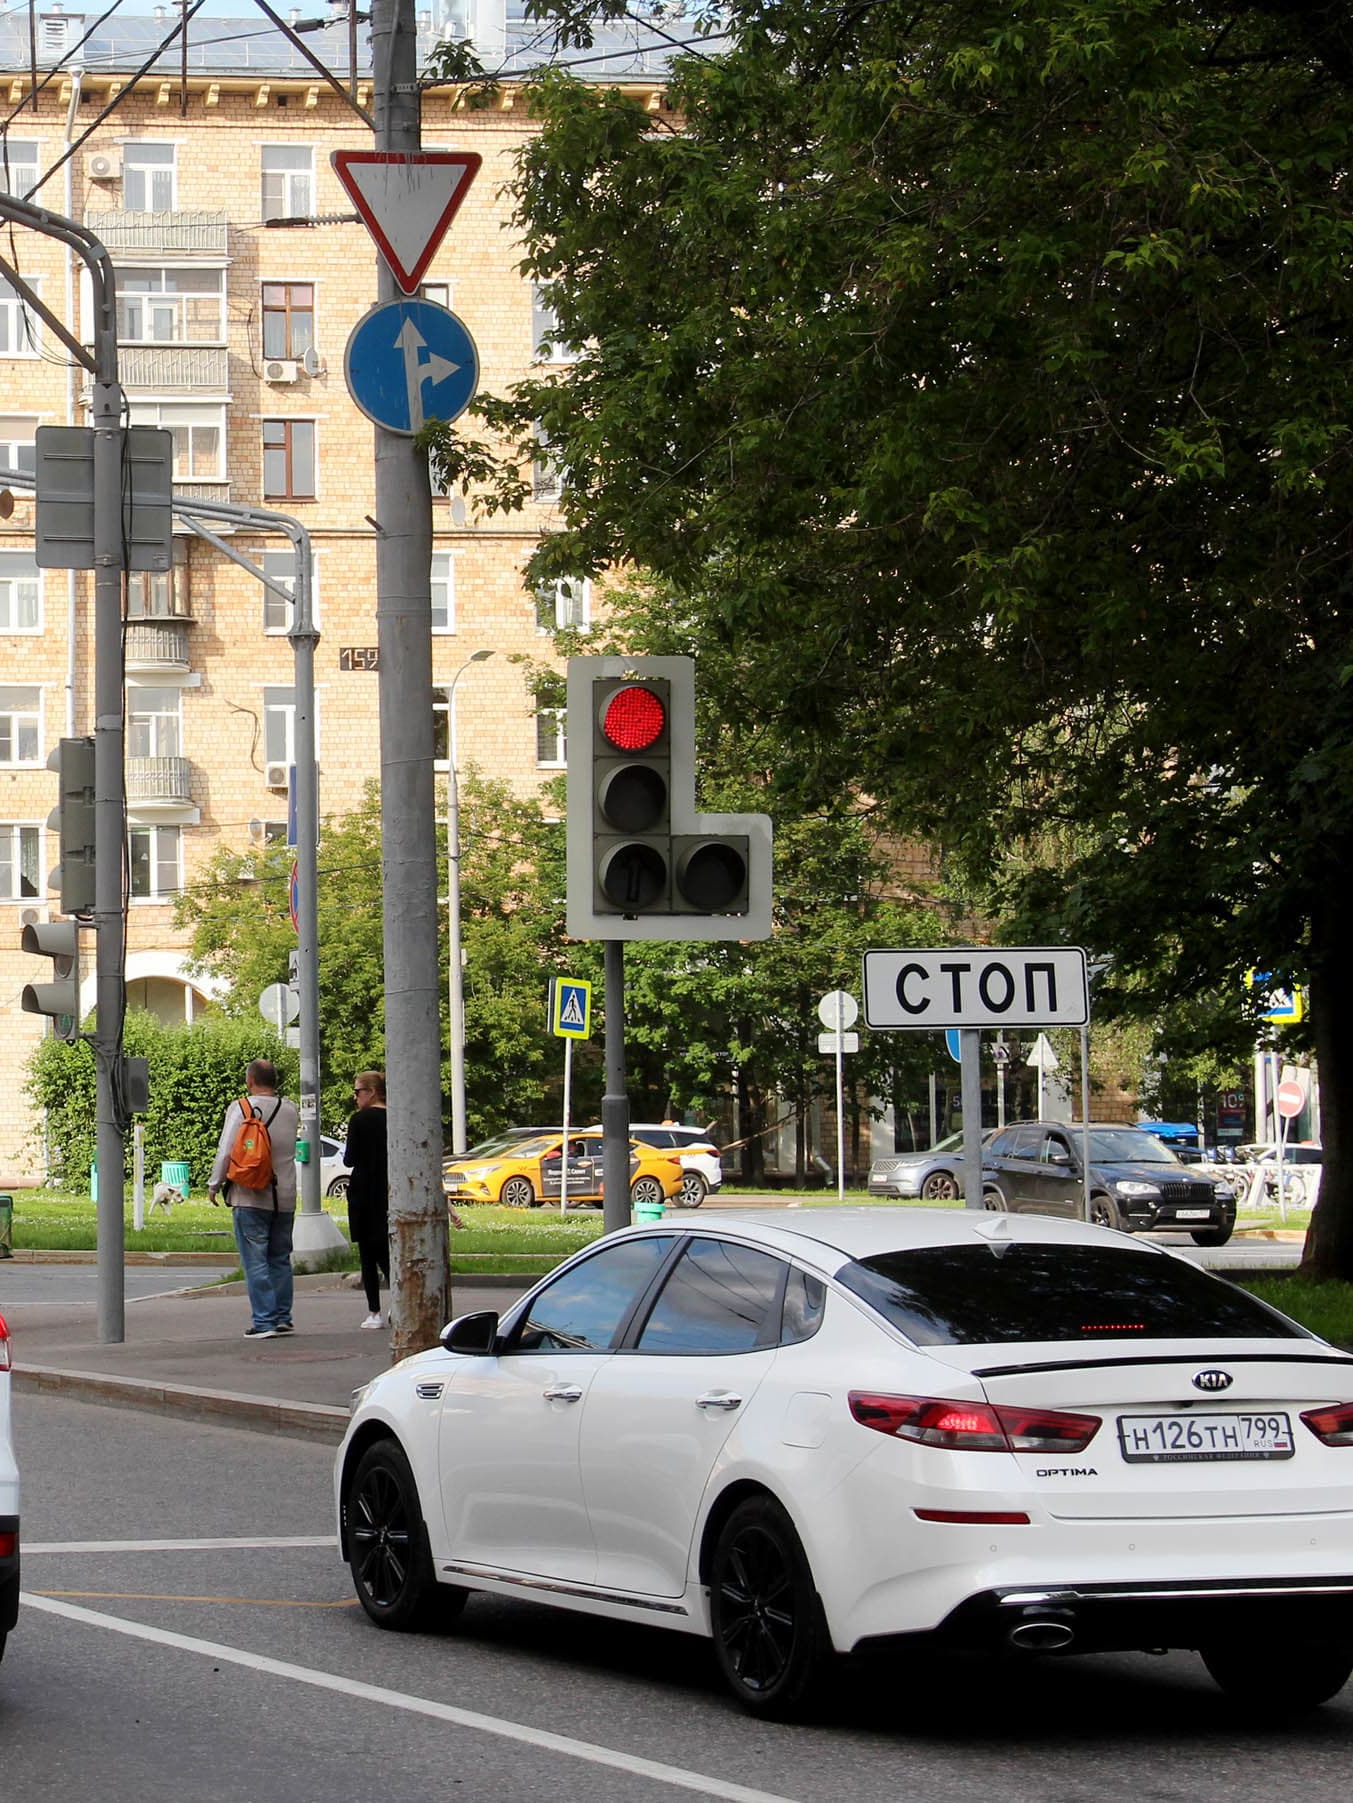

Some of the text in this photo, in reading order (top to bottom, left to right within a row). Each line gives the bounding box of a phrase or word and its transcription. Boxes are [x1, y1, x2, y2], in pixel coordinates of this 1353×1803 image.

[895, 962, 1058, 1015] СТОП
[1199, 1373, 1229, 1387] KIA
[1132, 1417, 1281, 1451] Н126ТН 799
[1253, 1440, 1273, 1448] RUS
[1036, 1468, 1098, 1477] OPTIMA
